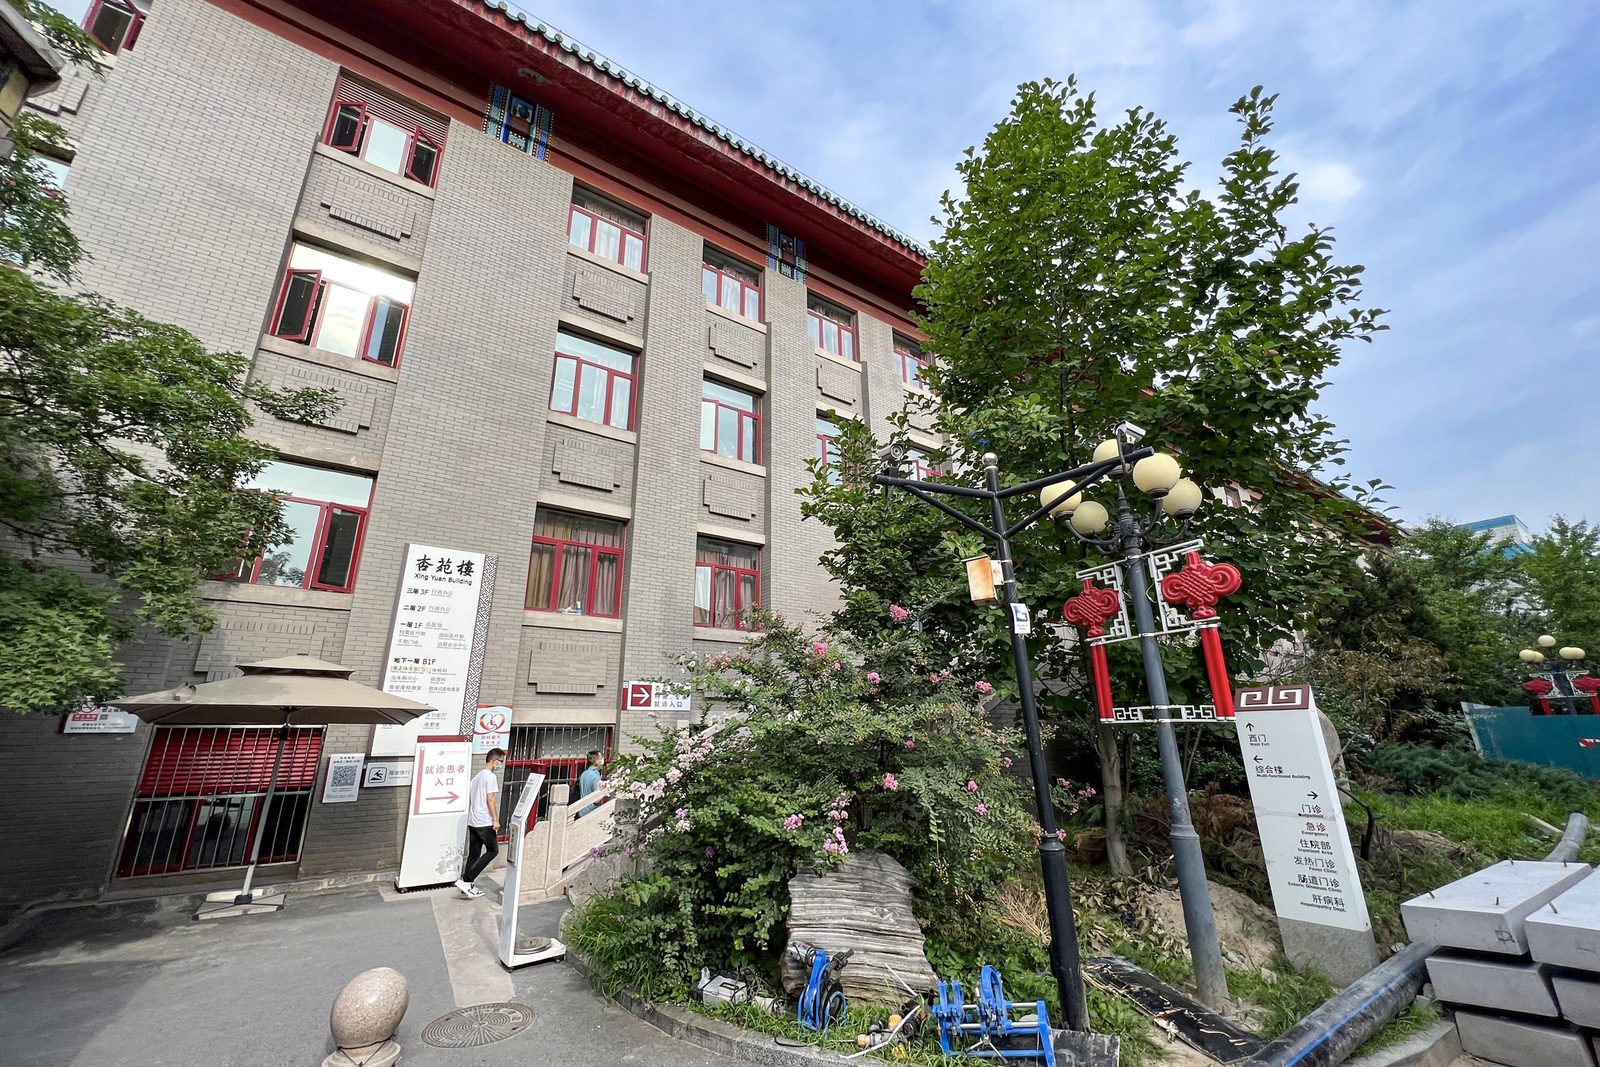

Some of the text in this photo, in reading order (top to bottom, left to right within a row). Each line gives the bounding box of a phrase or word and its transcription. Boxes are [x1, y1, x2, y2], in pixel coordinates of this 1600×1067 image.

[414, 572, 473, 586] Xing Yuan Building
[420, 588, 429, 596] 3F
[1248, 734, 1267, 742] 西门
[425, 764, 466, 775] 就诊患者
[1255, 765, 1284, 774] 综合楼
[434, 777, 454, 787] 入口
[1301, 804, 1322, 814] 门诊
[1305, 821, 1326, 832] 急诊
[1299, 838, 1332, 850] 住院部
[1293, 855, 1335, 869] 发热门诊
[1298, 874, 1340, 888] 肠道门诊
[1312, 894, 1345, 907] 肝病科
